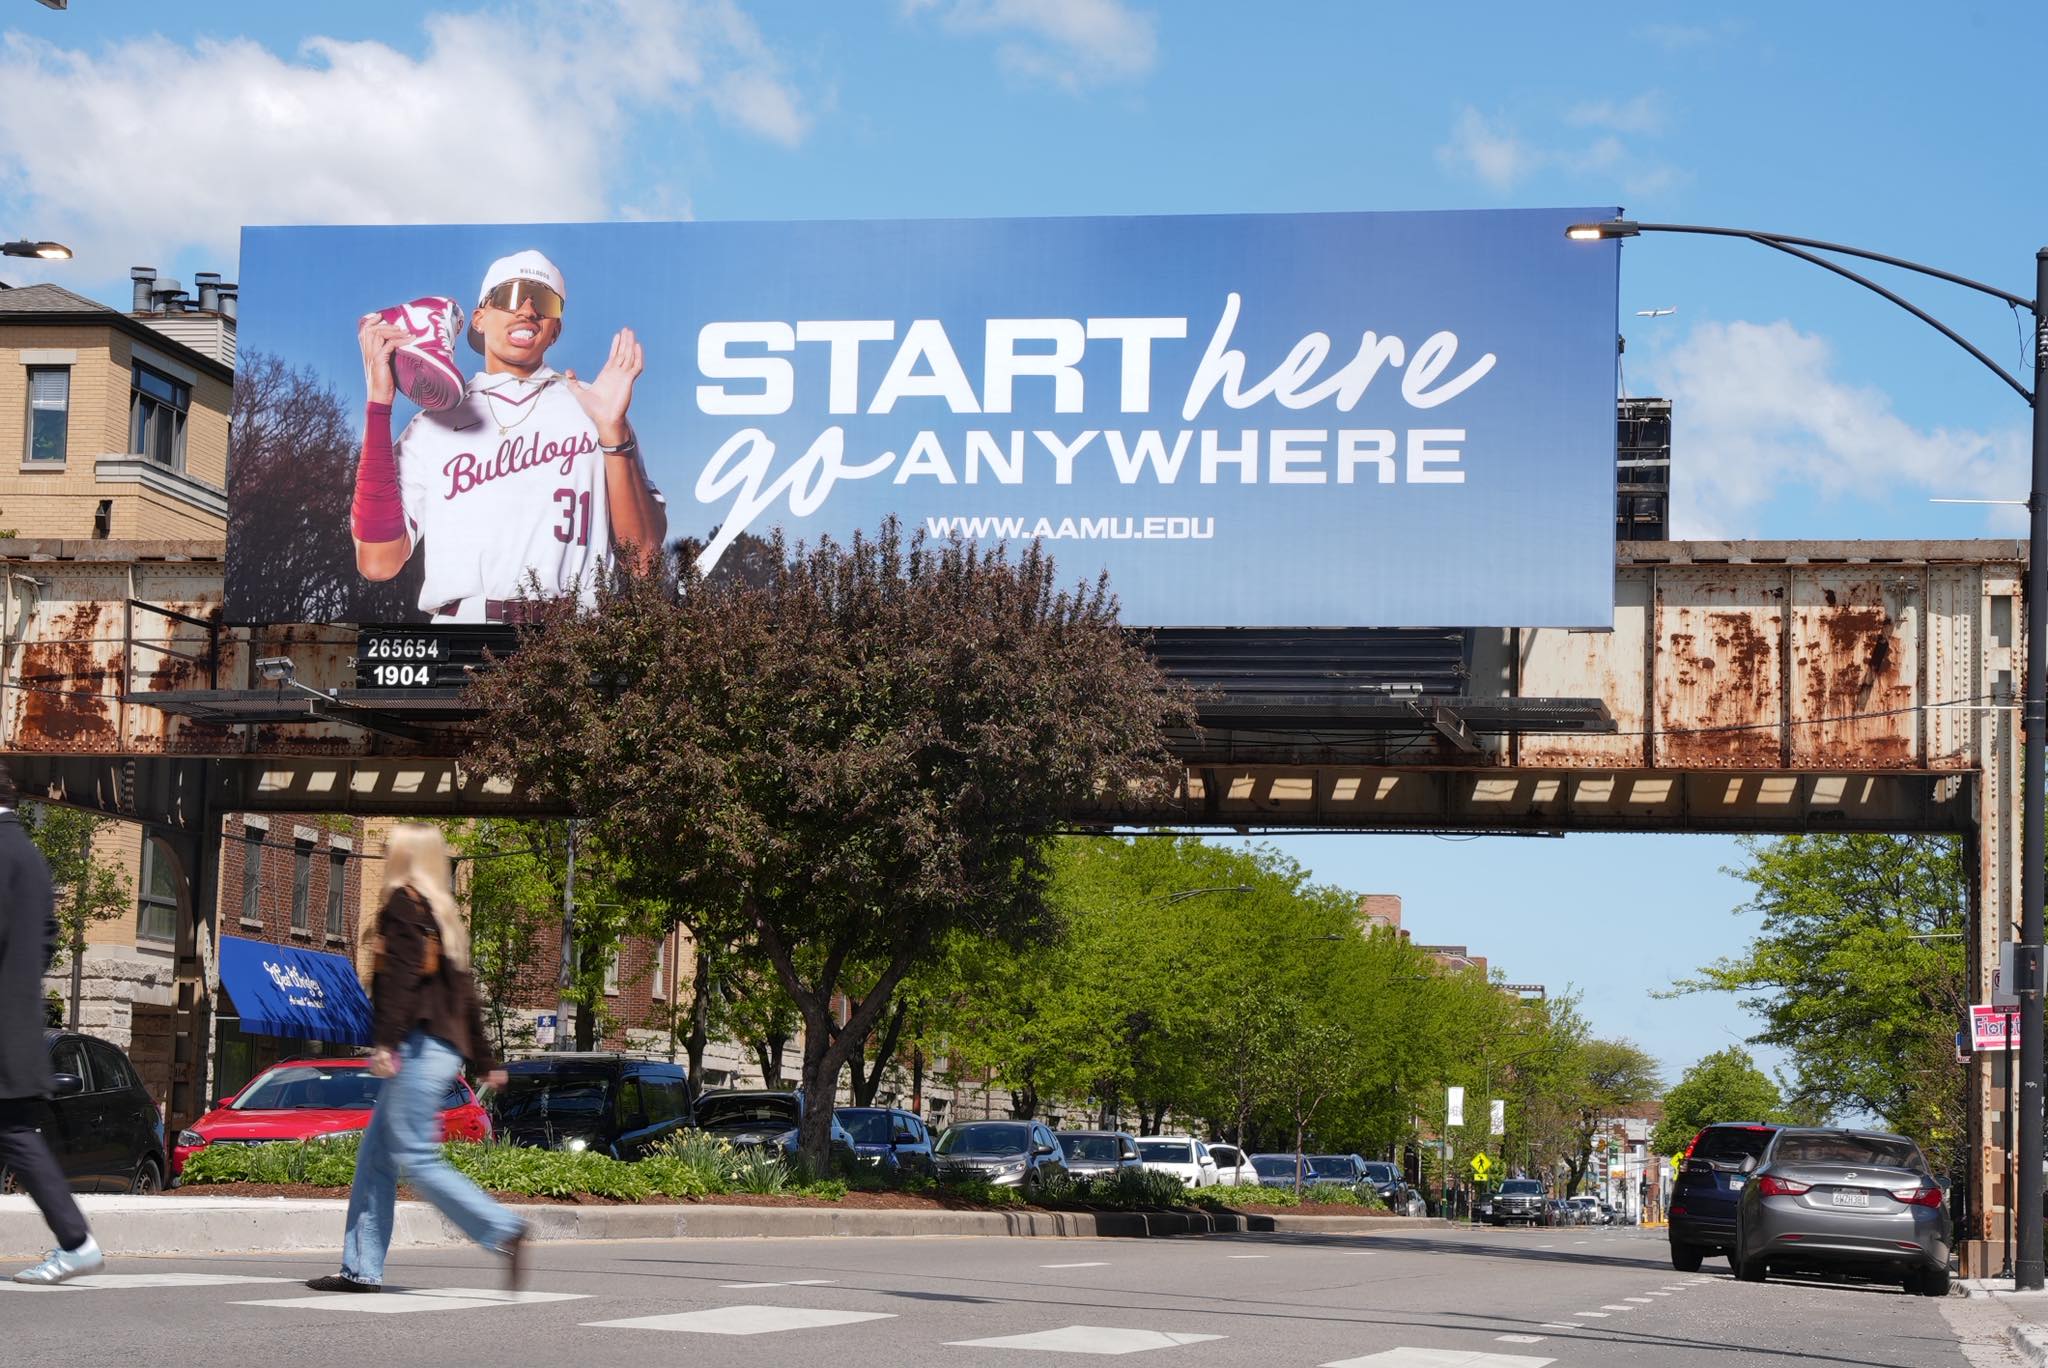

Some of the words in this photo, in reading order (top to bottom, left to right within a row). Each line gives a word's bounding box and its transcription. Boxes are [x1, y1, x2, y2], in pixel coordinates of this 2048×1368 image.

[696, 317, 1188, 415] START
[1182, 292, 1497, 422] here
[442, 431, 598, 500] Bulldogs
[553, 488, 591, 547] 31
[692, 426, 895, 580] go
[893, 429, 1466, 485] ANYWHERE
[926, 516, 1215, 540] WWW.AAMU.EDU
[367, 638, 439, 658] 265654
[373, 665, 430, 686] 1904
[1975, 1016, 2020, 1035] Fiort
